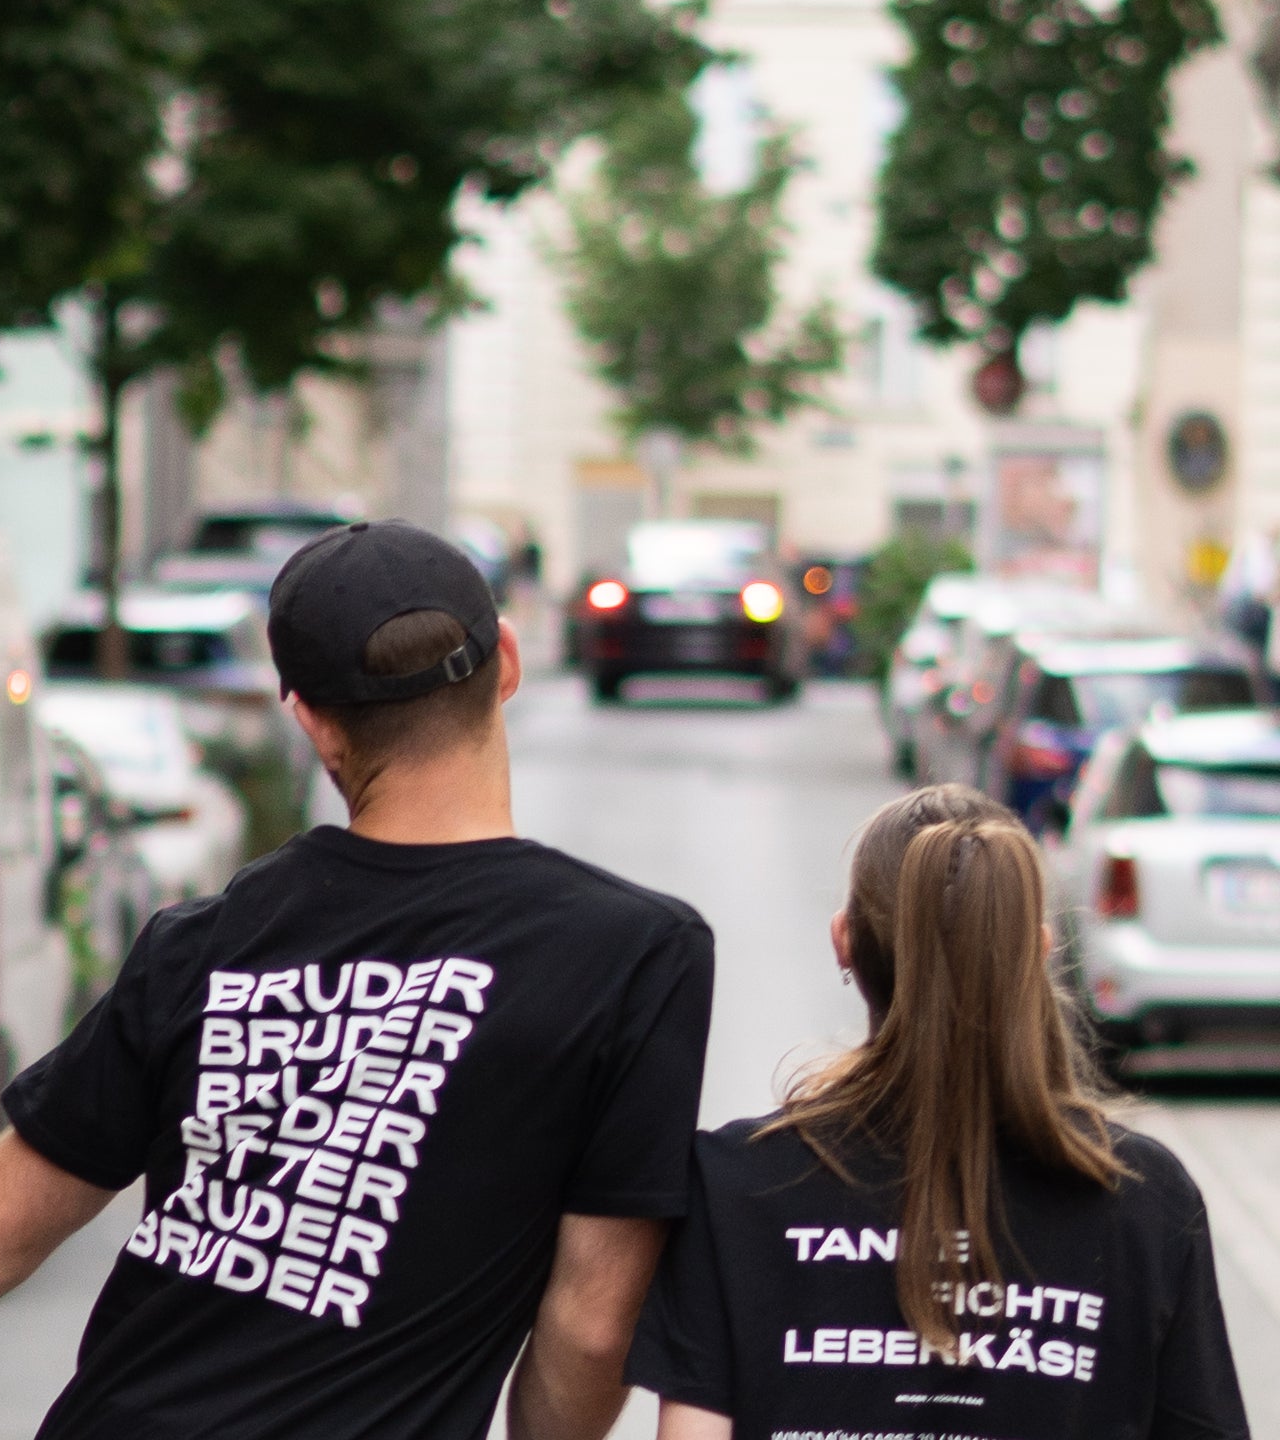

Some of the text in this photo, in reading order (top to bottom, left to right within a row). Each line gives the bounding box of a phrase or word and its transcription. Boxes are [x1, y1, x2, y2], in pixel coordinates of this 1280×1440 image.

[203, 958, 494, 1013] BRUDER
[199, 1006, 473, 1067] BRUDER
[126, 1210, 371, 1328] BRUDER
[785, 1227, 969, 1263] TANE
